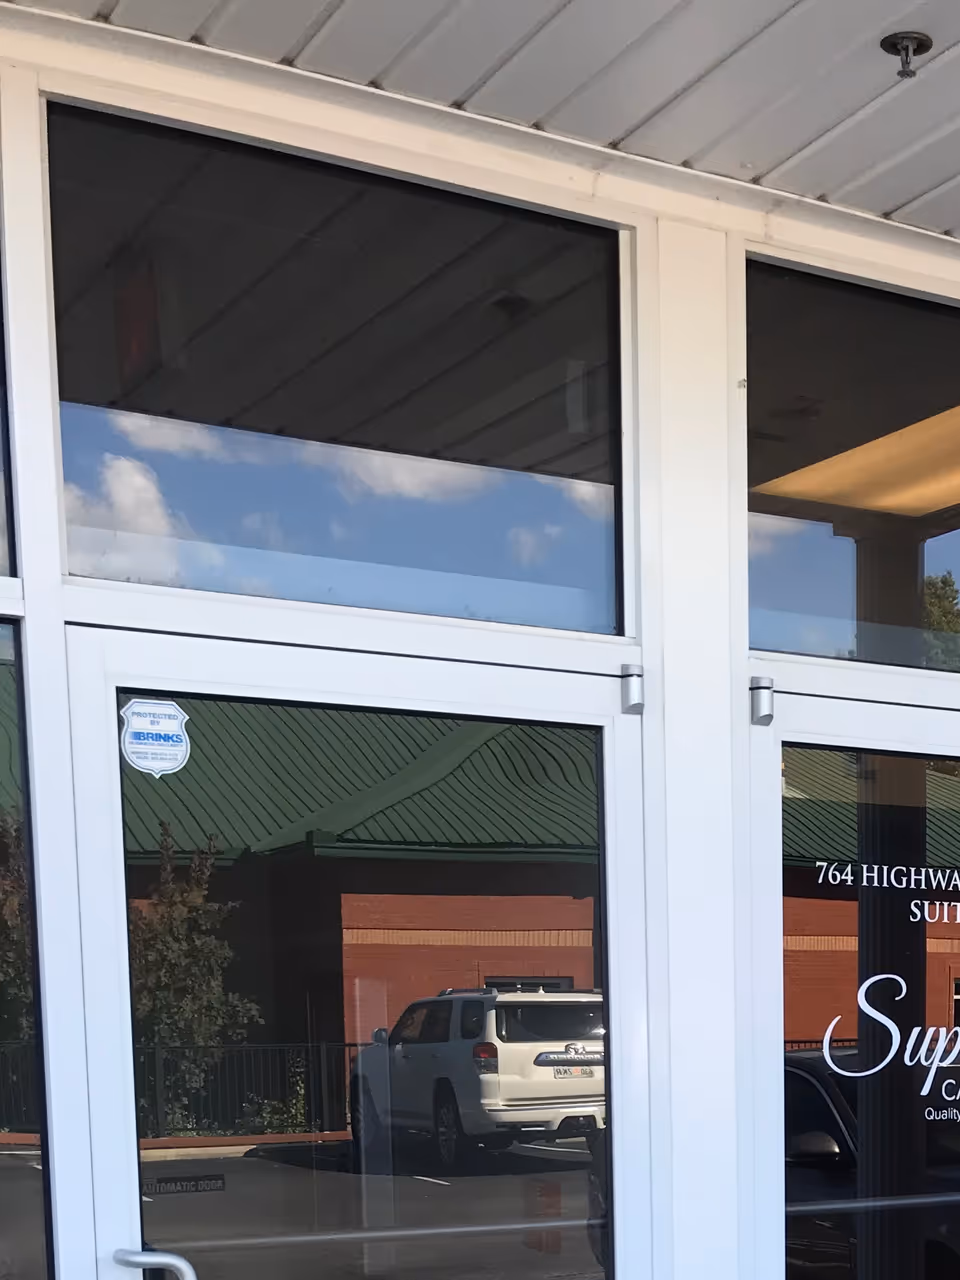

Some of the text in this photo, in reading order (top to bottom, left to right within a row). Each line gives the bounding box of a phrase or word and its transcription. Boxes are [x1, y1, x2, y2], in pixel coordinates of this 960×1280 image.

[131, 712, 179, 720] PROTECTED
[138, 732, 184, 743] BRINKS
[815, 861, 854, 885] 764
